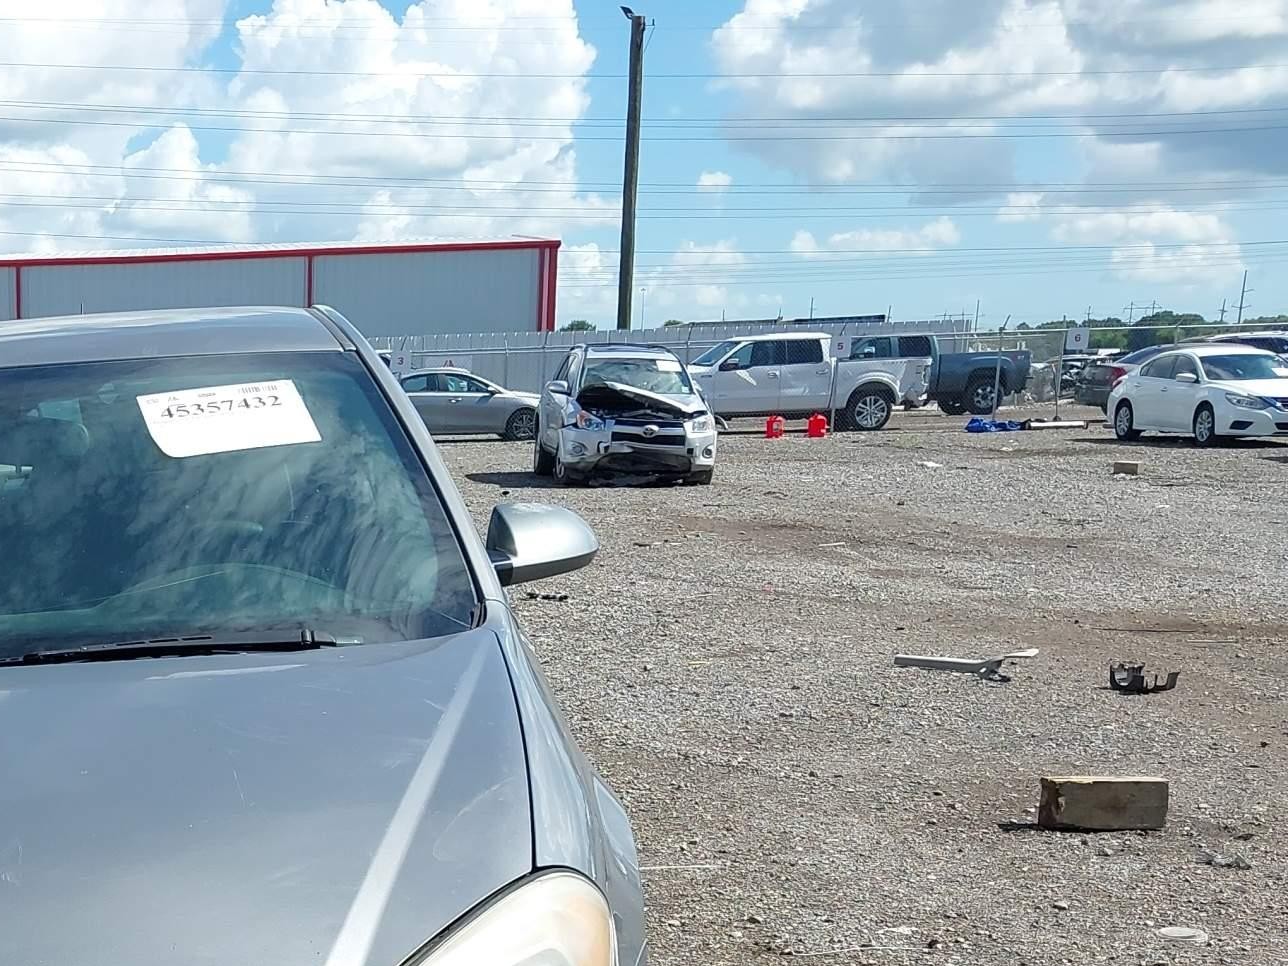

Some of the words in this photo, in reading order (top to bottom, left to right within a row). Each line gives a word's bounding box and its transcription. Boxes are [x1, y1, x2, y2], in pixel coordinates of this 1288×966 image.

[1074, 333, 1081, 342] 6
[837, 342, 844, 351] 5
[397, 356, 404, 366] 3
[161, 395, 282, 419] 45357432
